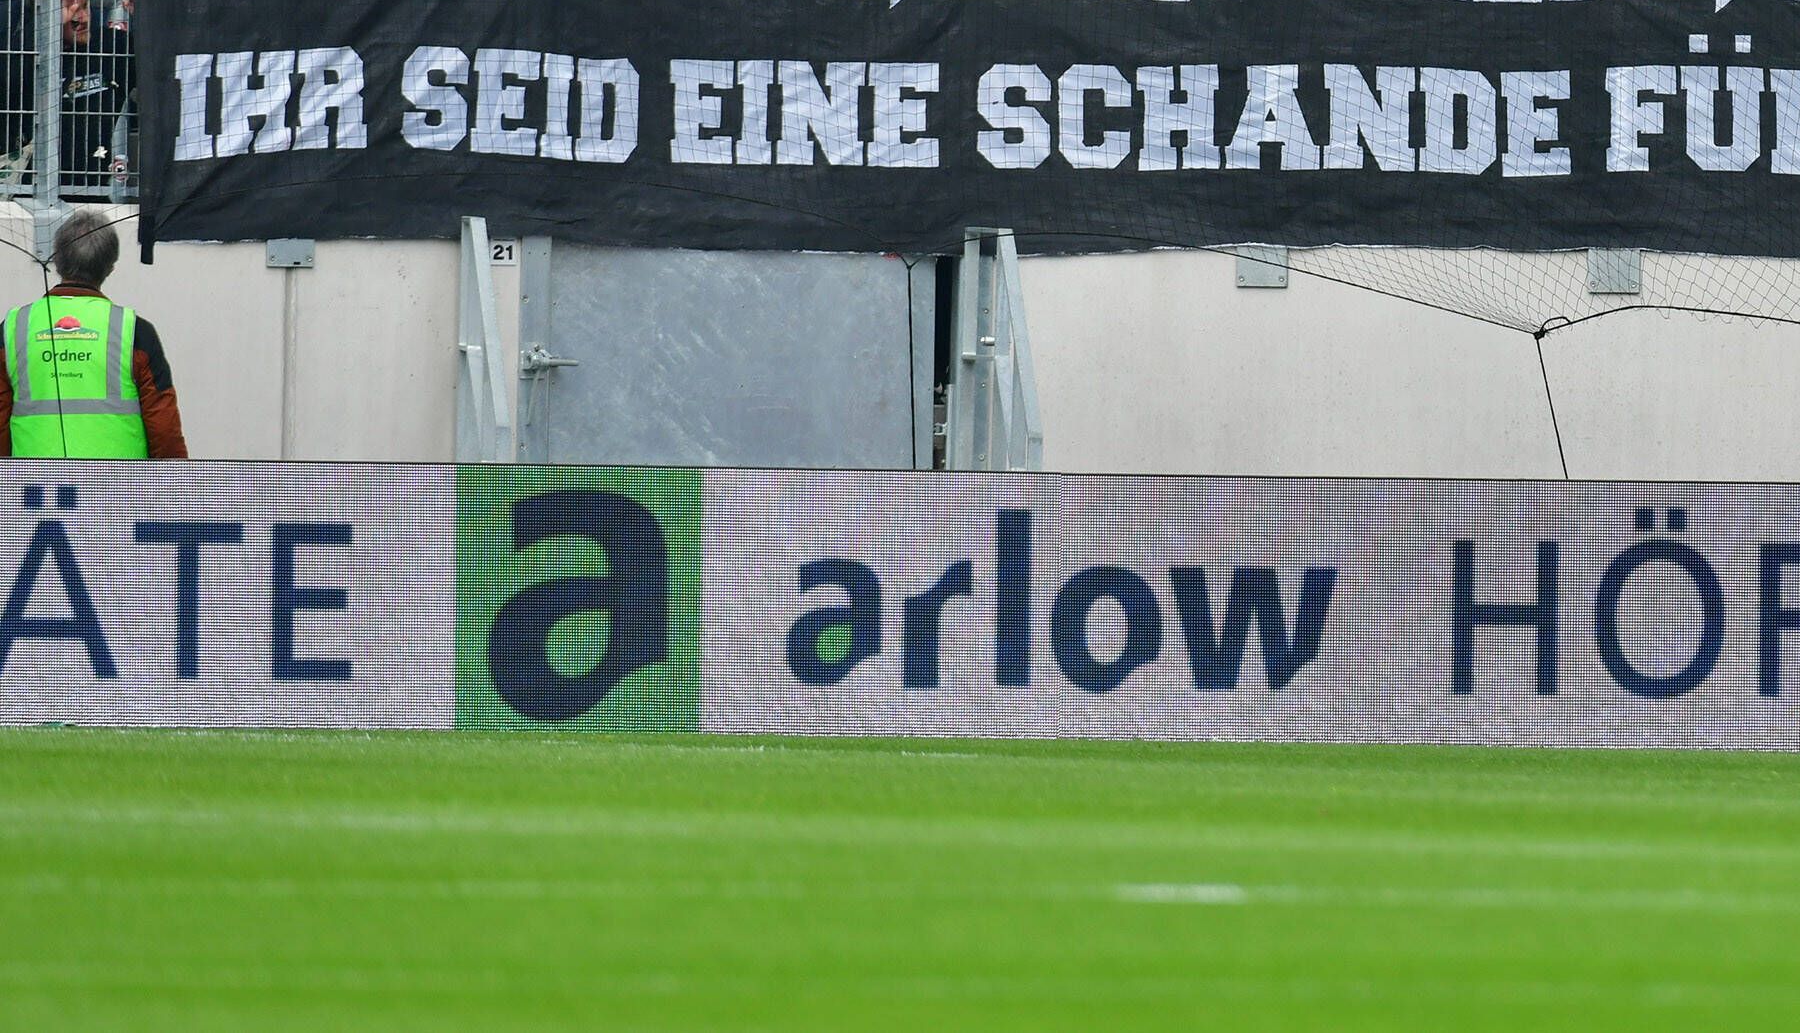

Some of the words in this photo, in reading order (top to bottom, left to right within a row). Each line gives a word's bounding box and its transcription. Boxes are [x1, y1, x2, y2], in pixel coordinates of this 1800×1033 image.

[174, 46, 368, 162] IHR
[400, 46, 640, 164] SEID
[669, 59, 940, 168] EINE
[976, 63, 1572, 179] SCHANDE
[493, 244, 513, 261] 21
[42, 348, 93, 364] Ordner
[785, 508, 1338, 694] arlow
